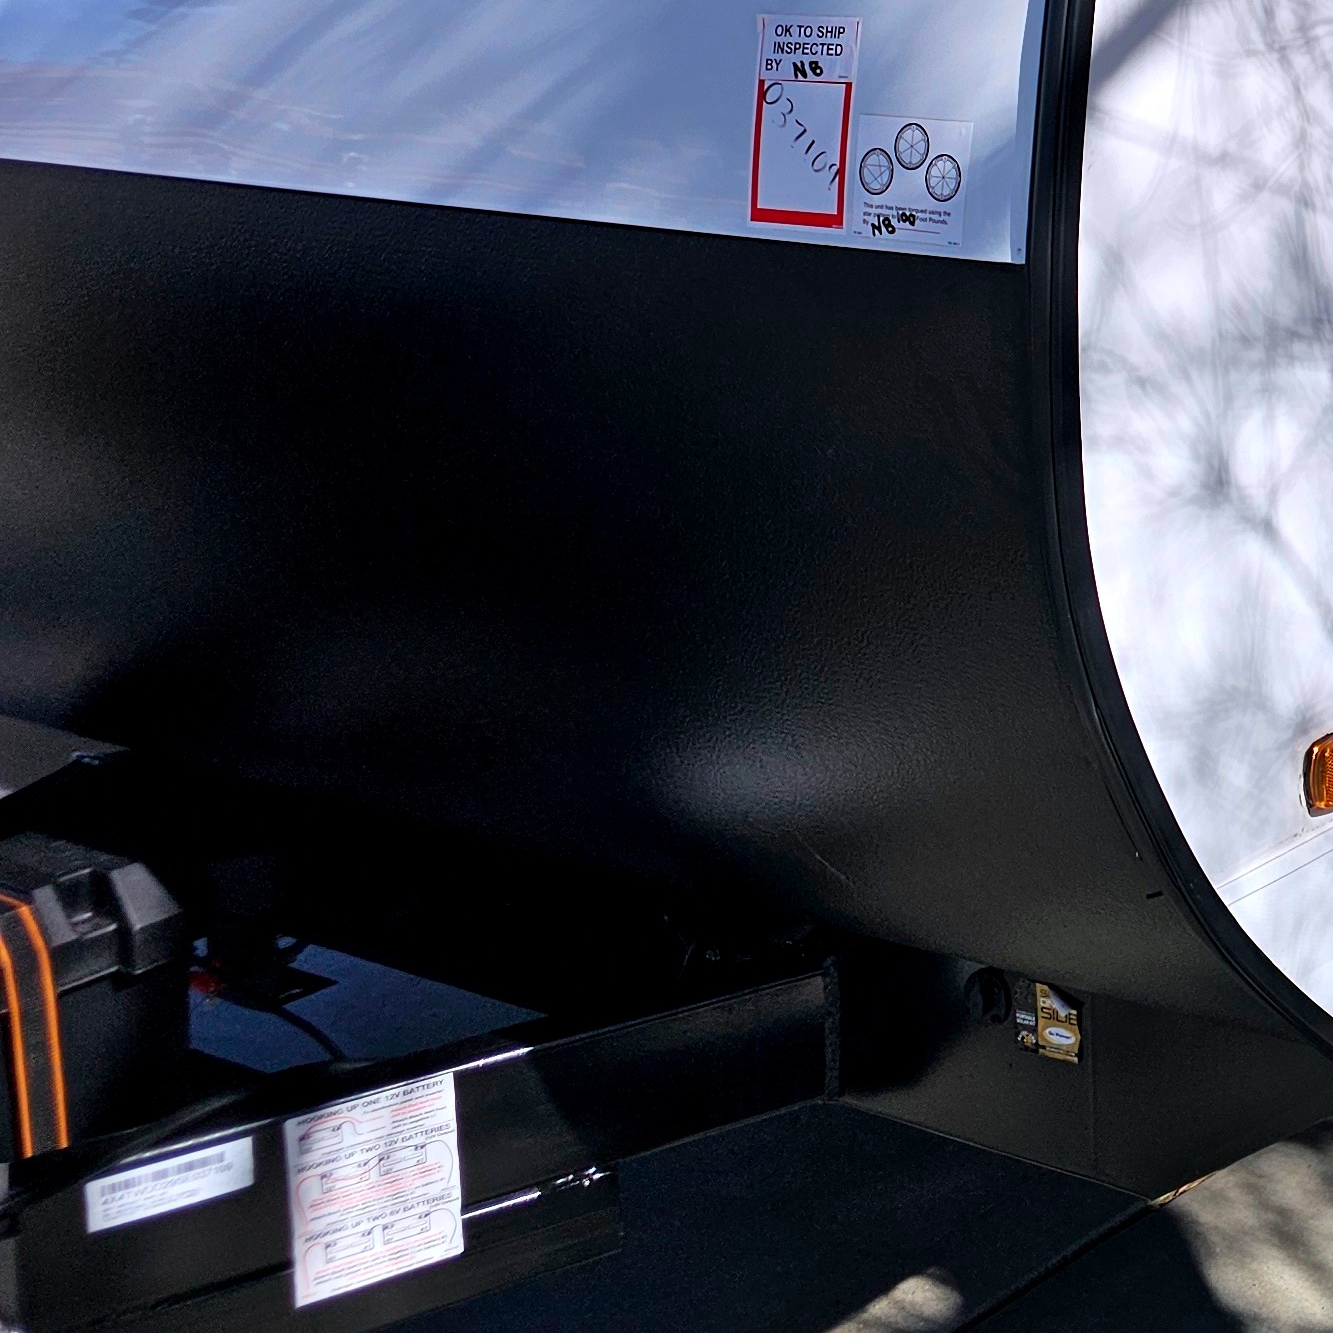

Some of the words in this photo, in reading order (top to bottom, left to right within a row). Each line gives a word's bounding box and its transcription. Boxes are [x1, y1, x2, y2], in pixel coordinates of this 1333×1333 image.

[774, 24, 793, 37] OK
[796, 24, 813, 38] TO
[816, 25, 846, 39] SHIP
[772, 41, 844, 57] INSPECTED
[765, 58, 782, 71] BY
[863, 201, 873, 209] This
[928, 209, 942, 217] using
[346, 1103, 359, 1113] UP
[362, 1097, 381, 1108] ONE
[385, 1091, 401, 1101] 12V
[403, 1079, 444, 1097] BATTERY
[344, 1150, 358, 1160] UP
[360, 1143, 380, 1155] TWO
[384, 1137, 400, 1148] 12V
[402, 1123, 451, 1143] BATTERIES
[351, 1220, 363, 1229] UP
[366, 1212, 387, 1223] TWO
[403, 1191, 452, 1213] BATTERIES
